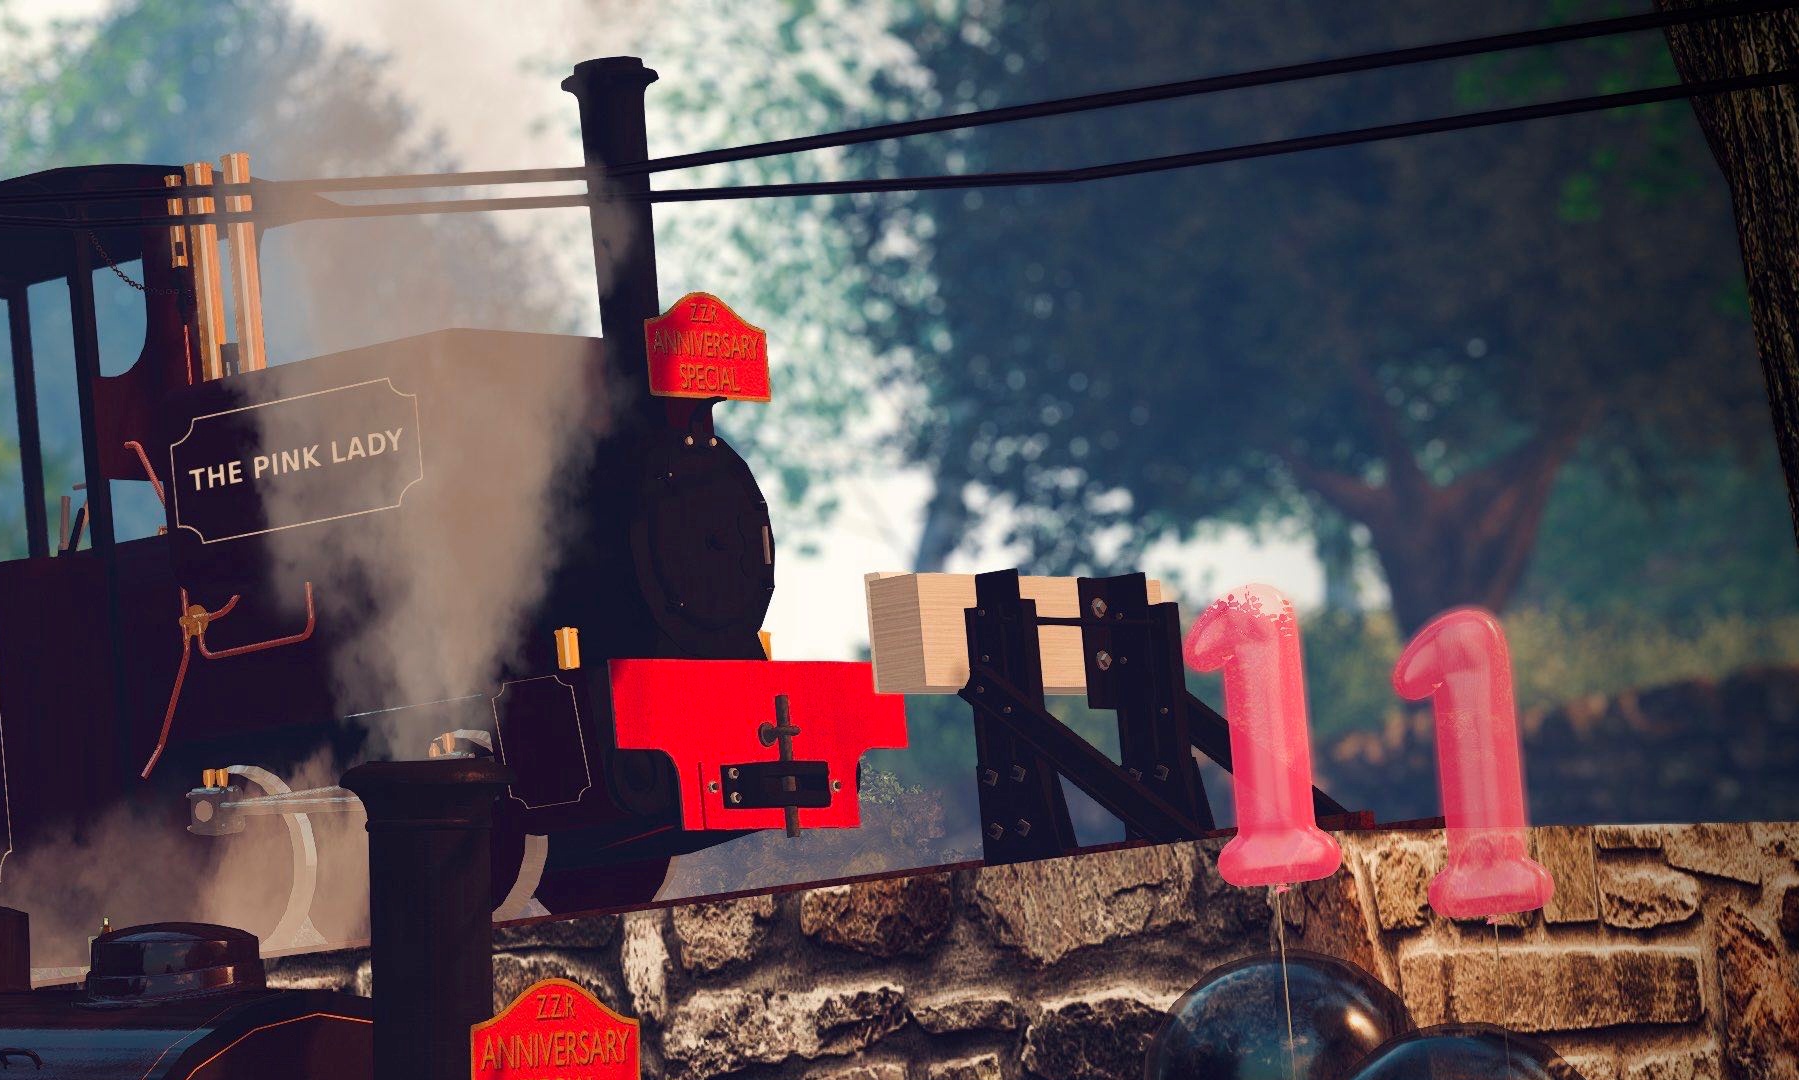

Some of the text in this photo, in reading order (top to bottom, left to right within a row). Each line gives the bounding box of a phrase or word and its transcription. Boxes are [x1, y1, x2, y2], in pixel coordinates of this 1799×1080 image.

[653, 328, 760, 361] ANNIVERSARY
[679, 363, 741, 392] SPECIAL
[188, 427, 403, 491] THE PINK LADY
[480, 1028, 631, 1072] ANNIVERSARY
